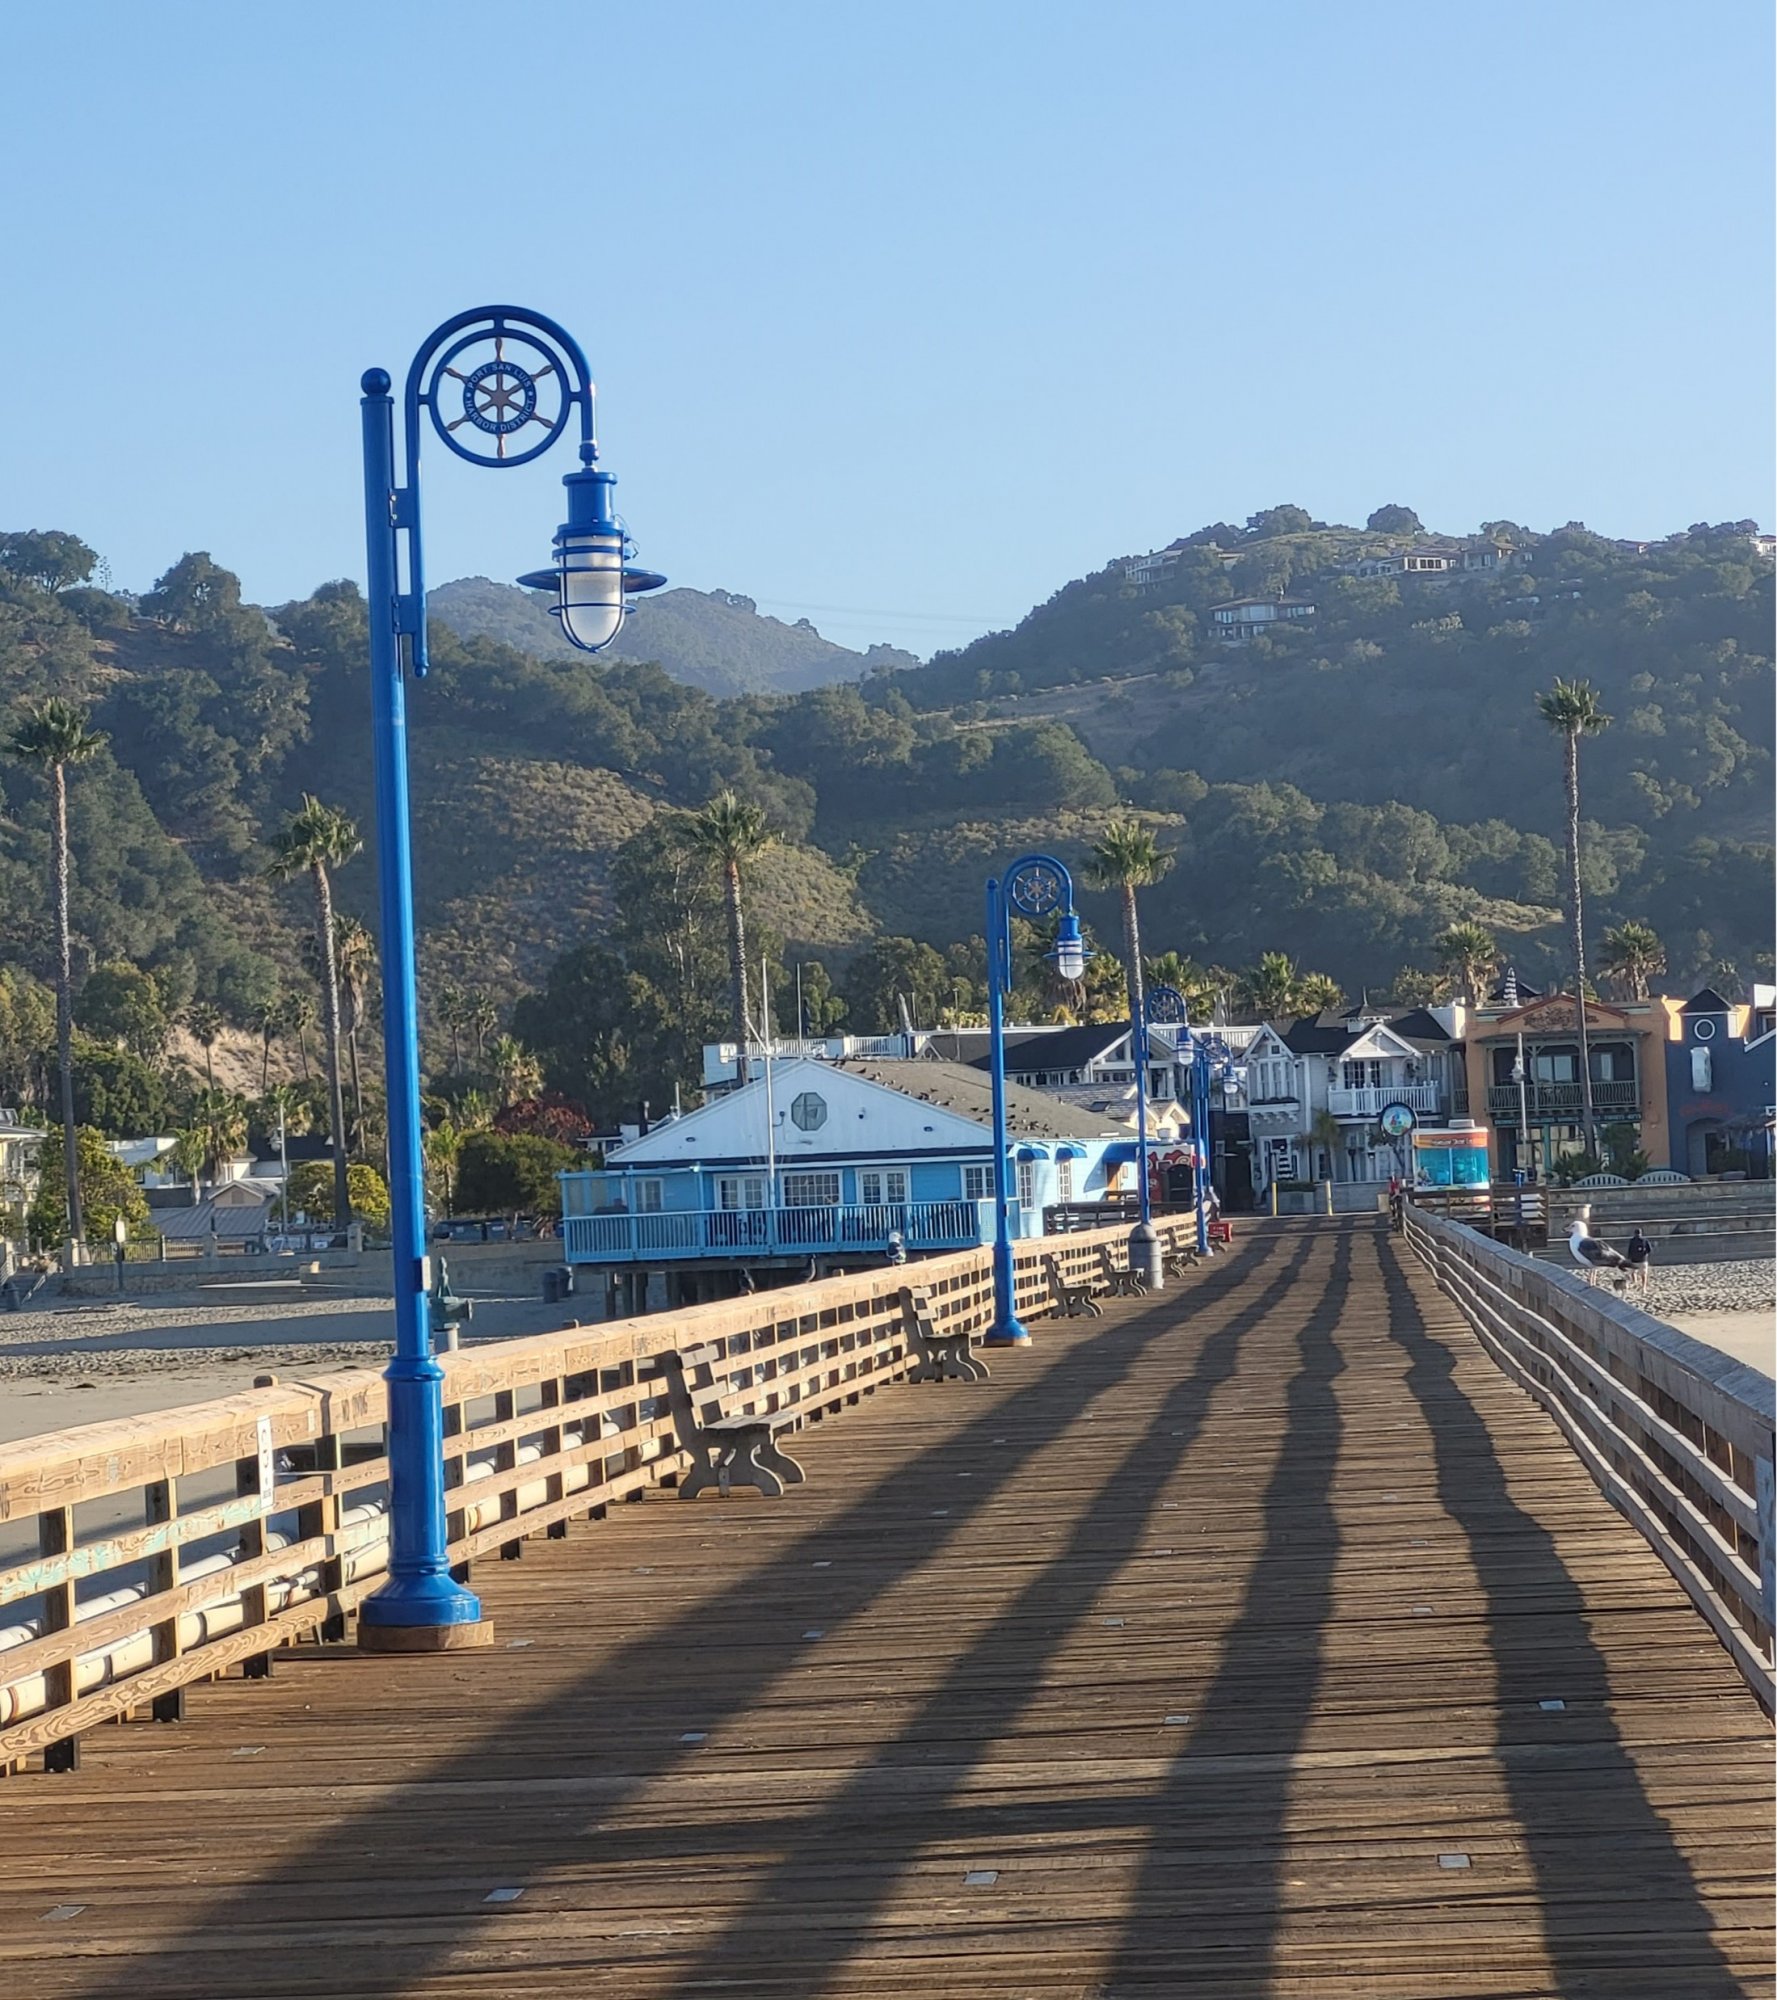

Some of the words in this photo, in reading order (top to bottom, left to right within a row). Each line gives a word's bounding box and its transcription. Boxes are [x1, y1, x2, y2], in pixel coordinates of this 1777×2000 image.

[468, 366, 489, 389] PORT
[513, 369, 532, 387] LUIS
[465, 400, 497, 432] HARBOR
[500, 399, 534, 432] DISTRICT
